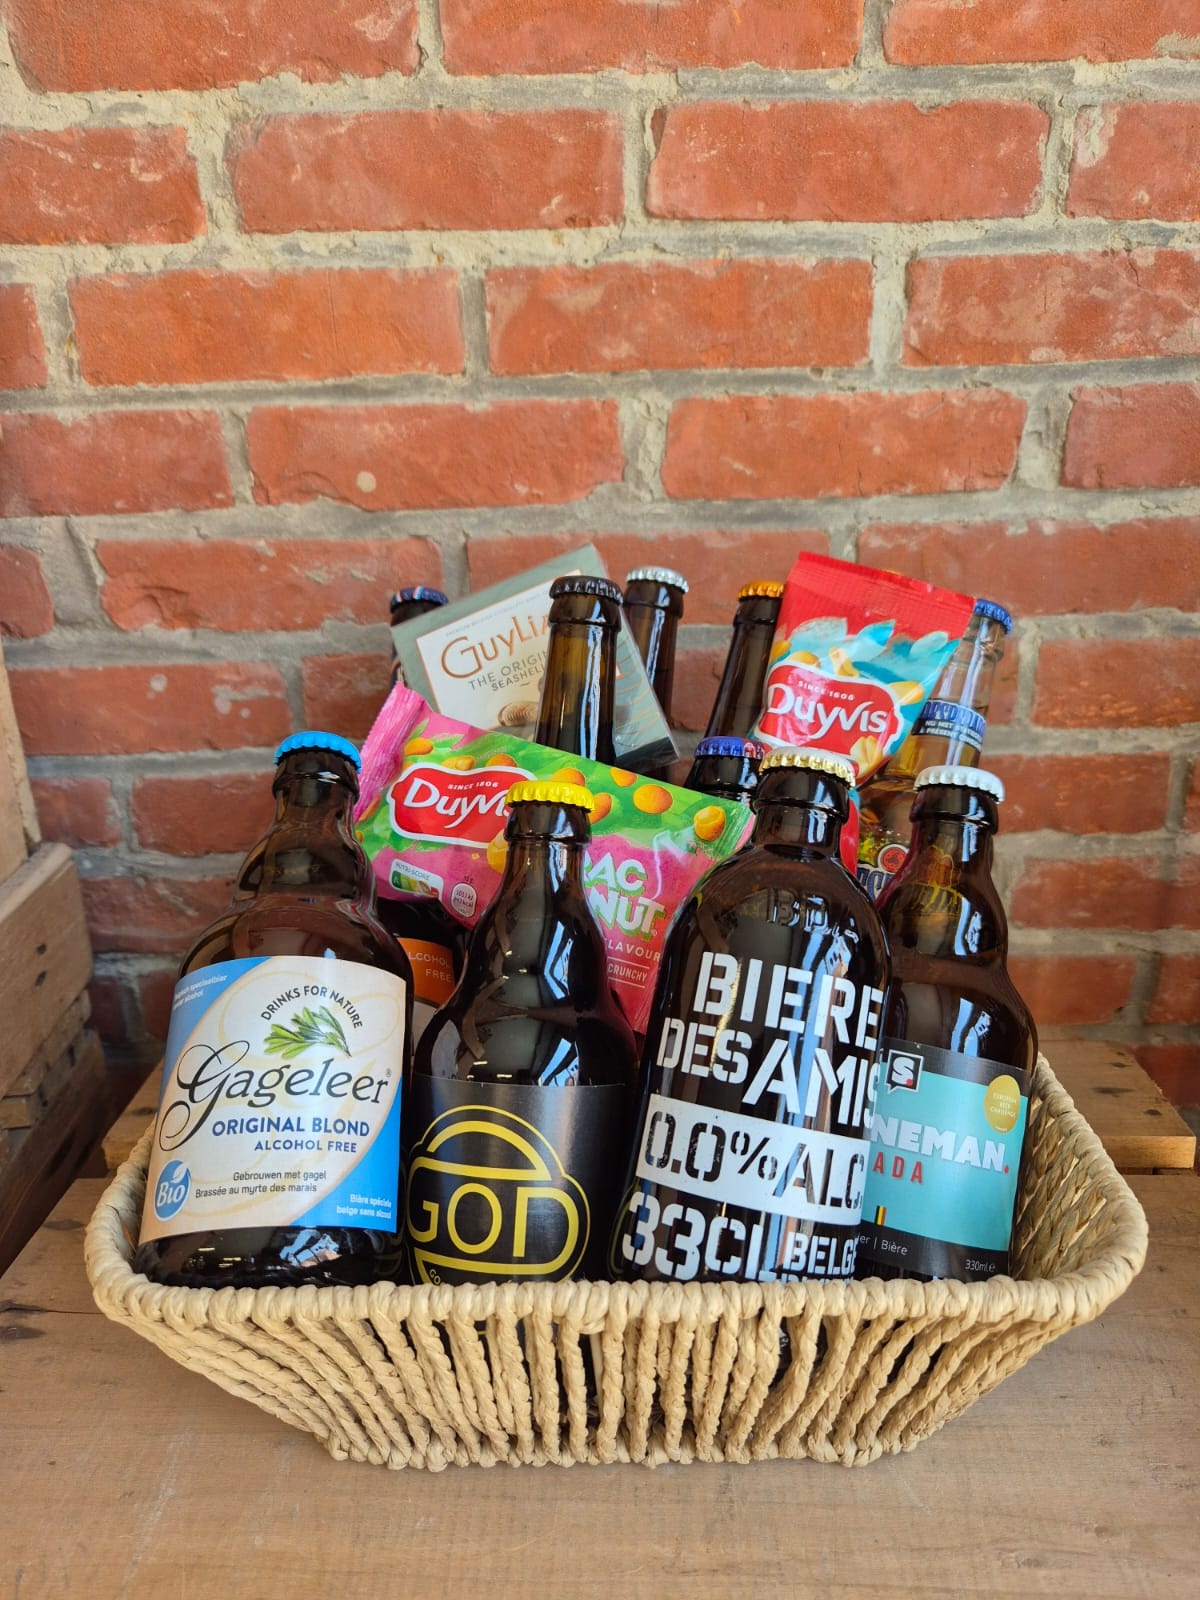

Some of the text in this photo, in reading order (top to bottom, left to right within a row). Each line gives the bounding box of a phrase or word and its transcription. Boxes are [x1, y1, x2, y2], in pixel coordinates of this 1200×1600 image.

[468, 672, 497, 690] THE
[798, 680, 826, 695] SINCE
[767, 683, 889, 739] Duyvis
[589, 887, 666, 936] NUT
[408, 951, 450, 968] LCOHOL
[605, 939, 661, 961] LAVOUR
[425, 968, 452, 983] FREE
[608, 962, 647, 982] CRUNCHY
[261, 985, 363, 1029] DRINKS FOR NATURE
[693, 951, 884, 1051] BIERE
[656, 1017, 880, 1129] DES AMIS
[159, 1040, 388, 1152] Gageleer
[212, 1116, 370, 1137] ORIGINAL BLOND
[254, 1139, 357, 1153] ALCOHOL FREE
[645, 1110, 779, 1182] 0.0%
[871, 1113, 1009, 1174] NEMAN.
[233, 1170, 327, 1182] Gebrouwen met gagel
[872, 1151, 923, 1184] ADA
[195, 1183, 317, 1198] Brassée au myrte des marais
[407, 1157, 580, 1274] GOD
[622, 1191, 776, 1284] 33CL
[881, 1238, 909, 1256] Bière
